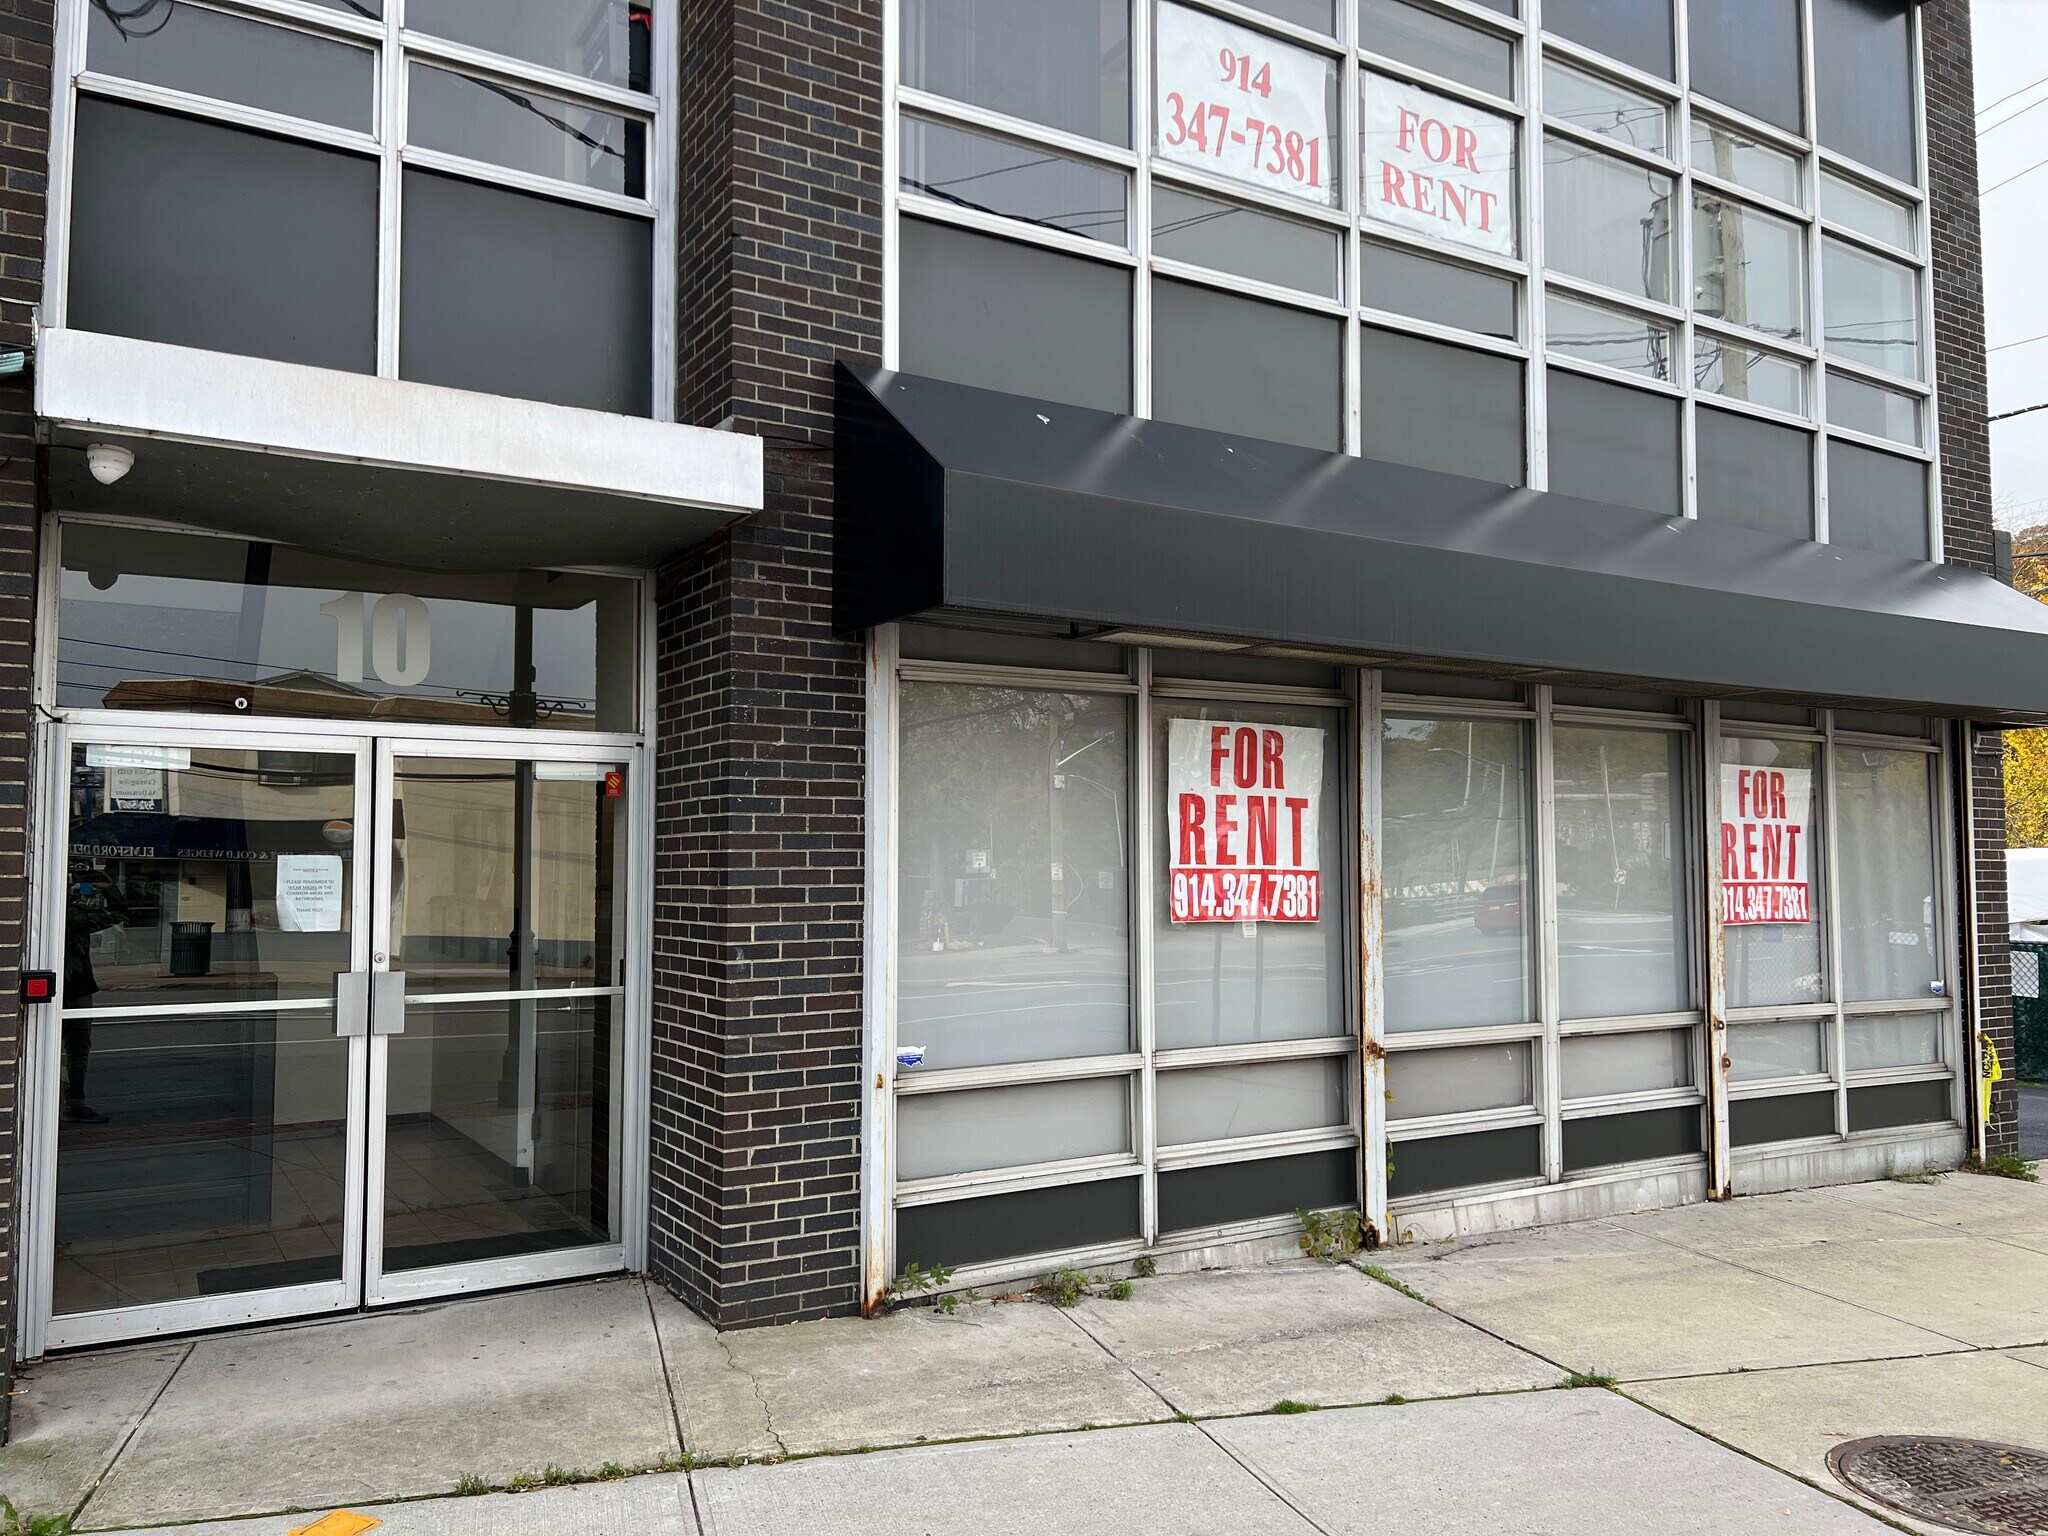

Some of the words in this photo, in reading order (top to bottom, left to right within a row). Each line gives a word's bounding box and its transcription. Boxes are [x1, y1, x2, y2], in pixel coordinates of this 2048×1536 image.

[1219, 48, 1272, 99] 914
[1166, 92, 1322, 188] 347-7381
[1396, 105, 1480, 174] FOR
[1380, 160, 1498, 233] RENT
[320, 590, 431, 687] 10
[1211, 726, 1285, 790] FOR
[1738, 769, 1786, 819] FOR
[1179, 793, 1309, 867] RENT
[1721, 823, 1801, 880] RENT
[1174, 872, 1317, 918] 914.347.7381
